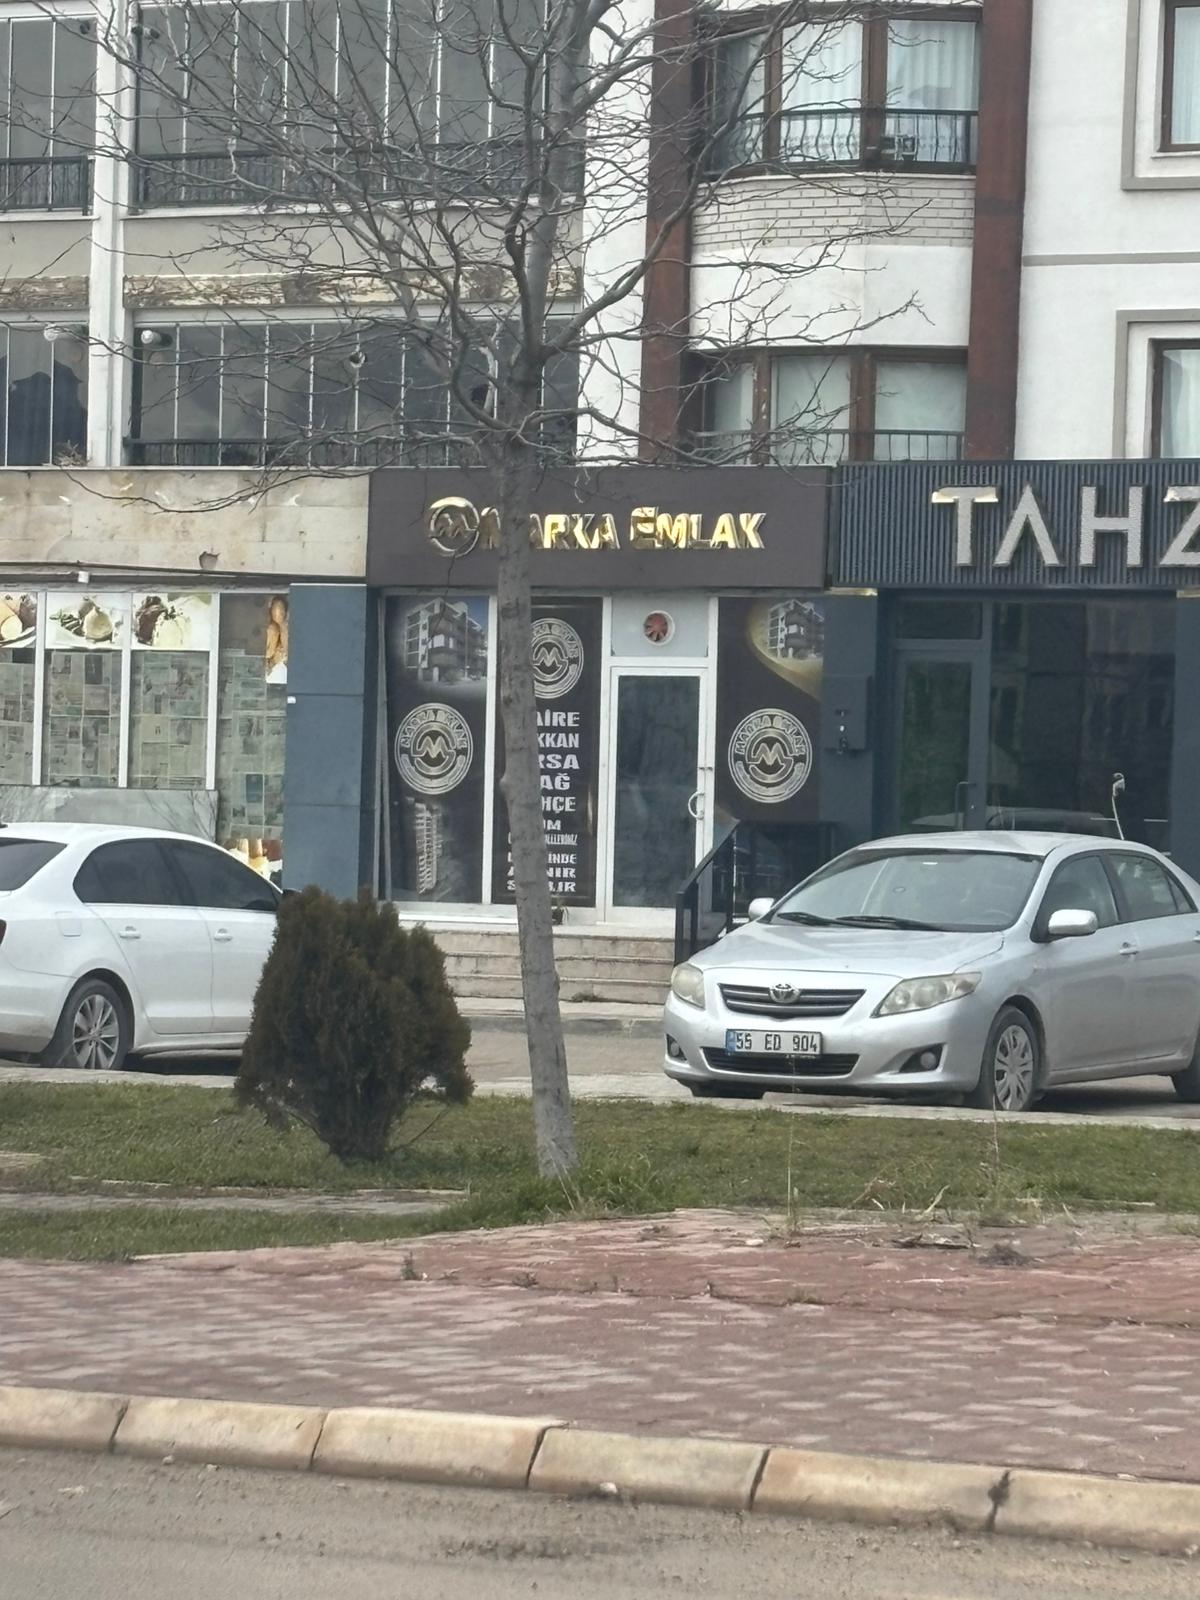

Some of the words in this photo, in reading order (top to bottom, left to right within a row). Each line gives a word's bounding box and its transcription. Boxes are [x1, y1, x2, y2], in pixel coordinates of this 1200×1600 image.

[629, 506, 766, 550] EMLAK
[537, 732, 580, 748] KKAN
[540, 772, 571, 790] AĞ
[541, 796, 577, 814] HÇE
[764, 1033, 781, 1051] ED
[792, 1035, 817, 1052] 904
